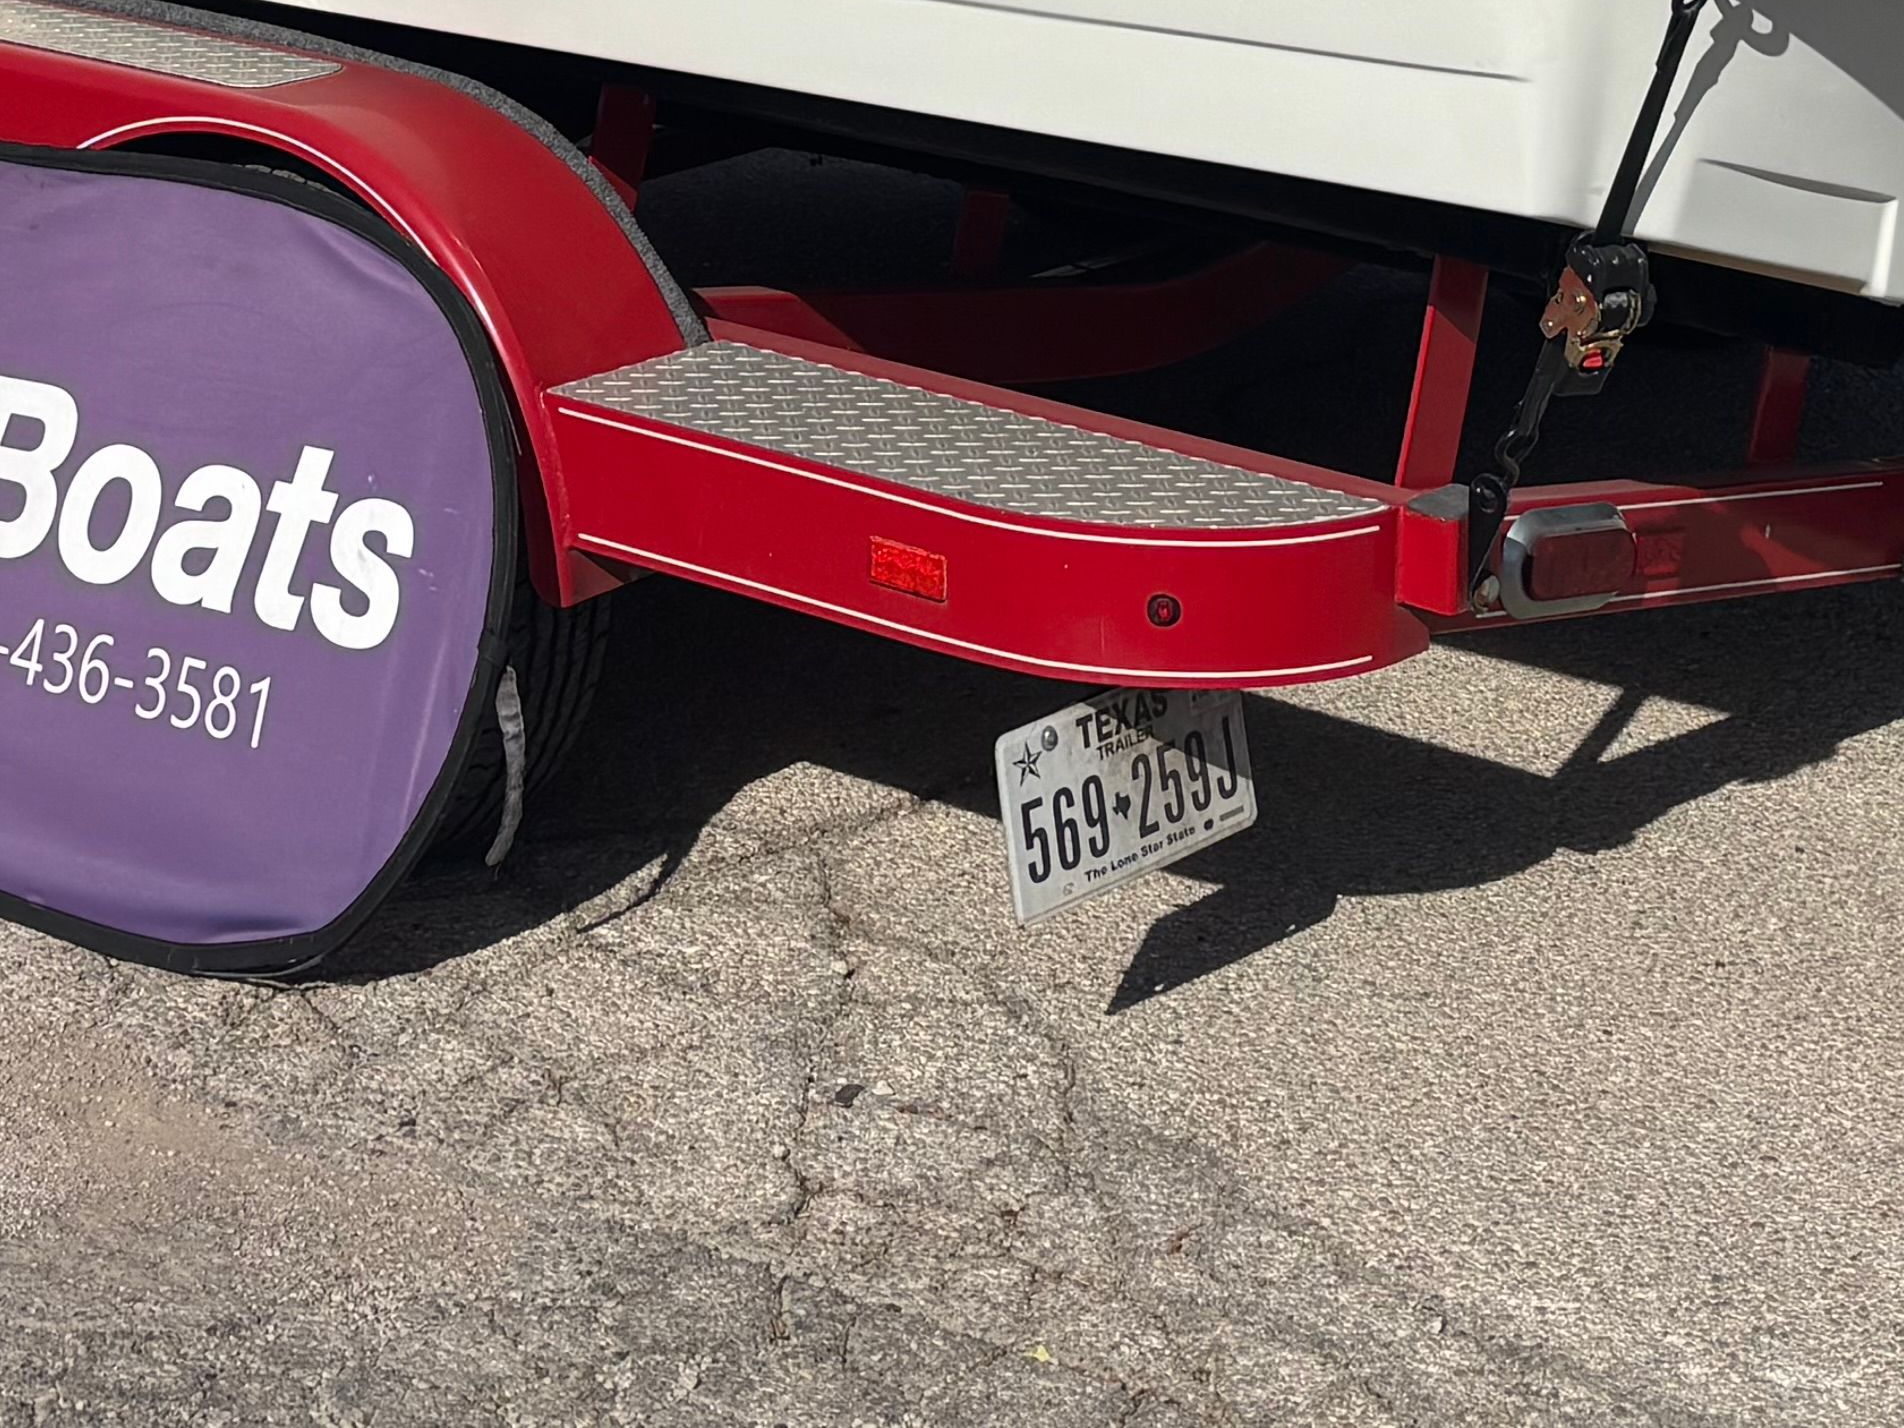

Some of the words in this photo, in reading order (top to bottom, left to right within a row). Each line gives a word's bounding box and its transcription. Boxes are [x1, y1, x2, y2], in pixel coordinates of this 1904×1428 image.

[1075, 689, 1169, 749] TEXAS
[1096, 726, 1156, 761] TRAILER
[1084, 865, 1108, 883] The
[1110, 852, 1139, 873] Lone
[1140, 840, 1165, 859] Star
[1166, 826, 1197, 847] State
